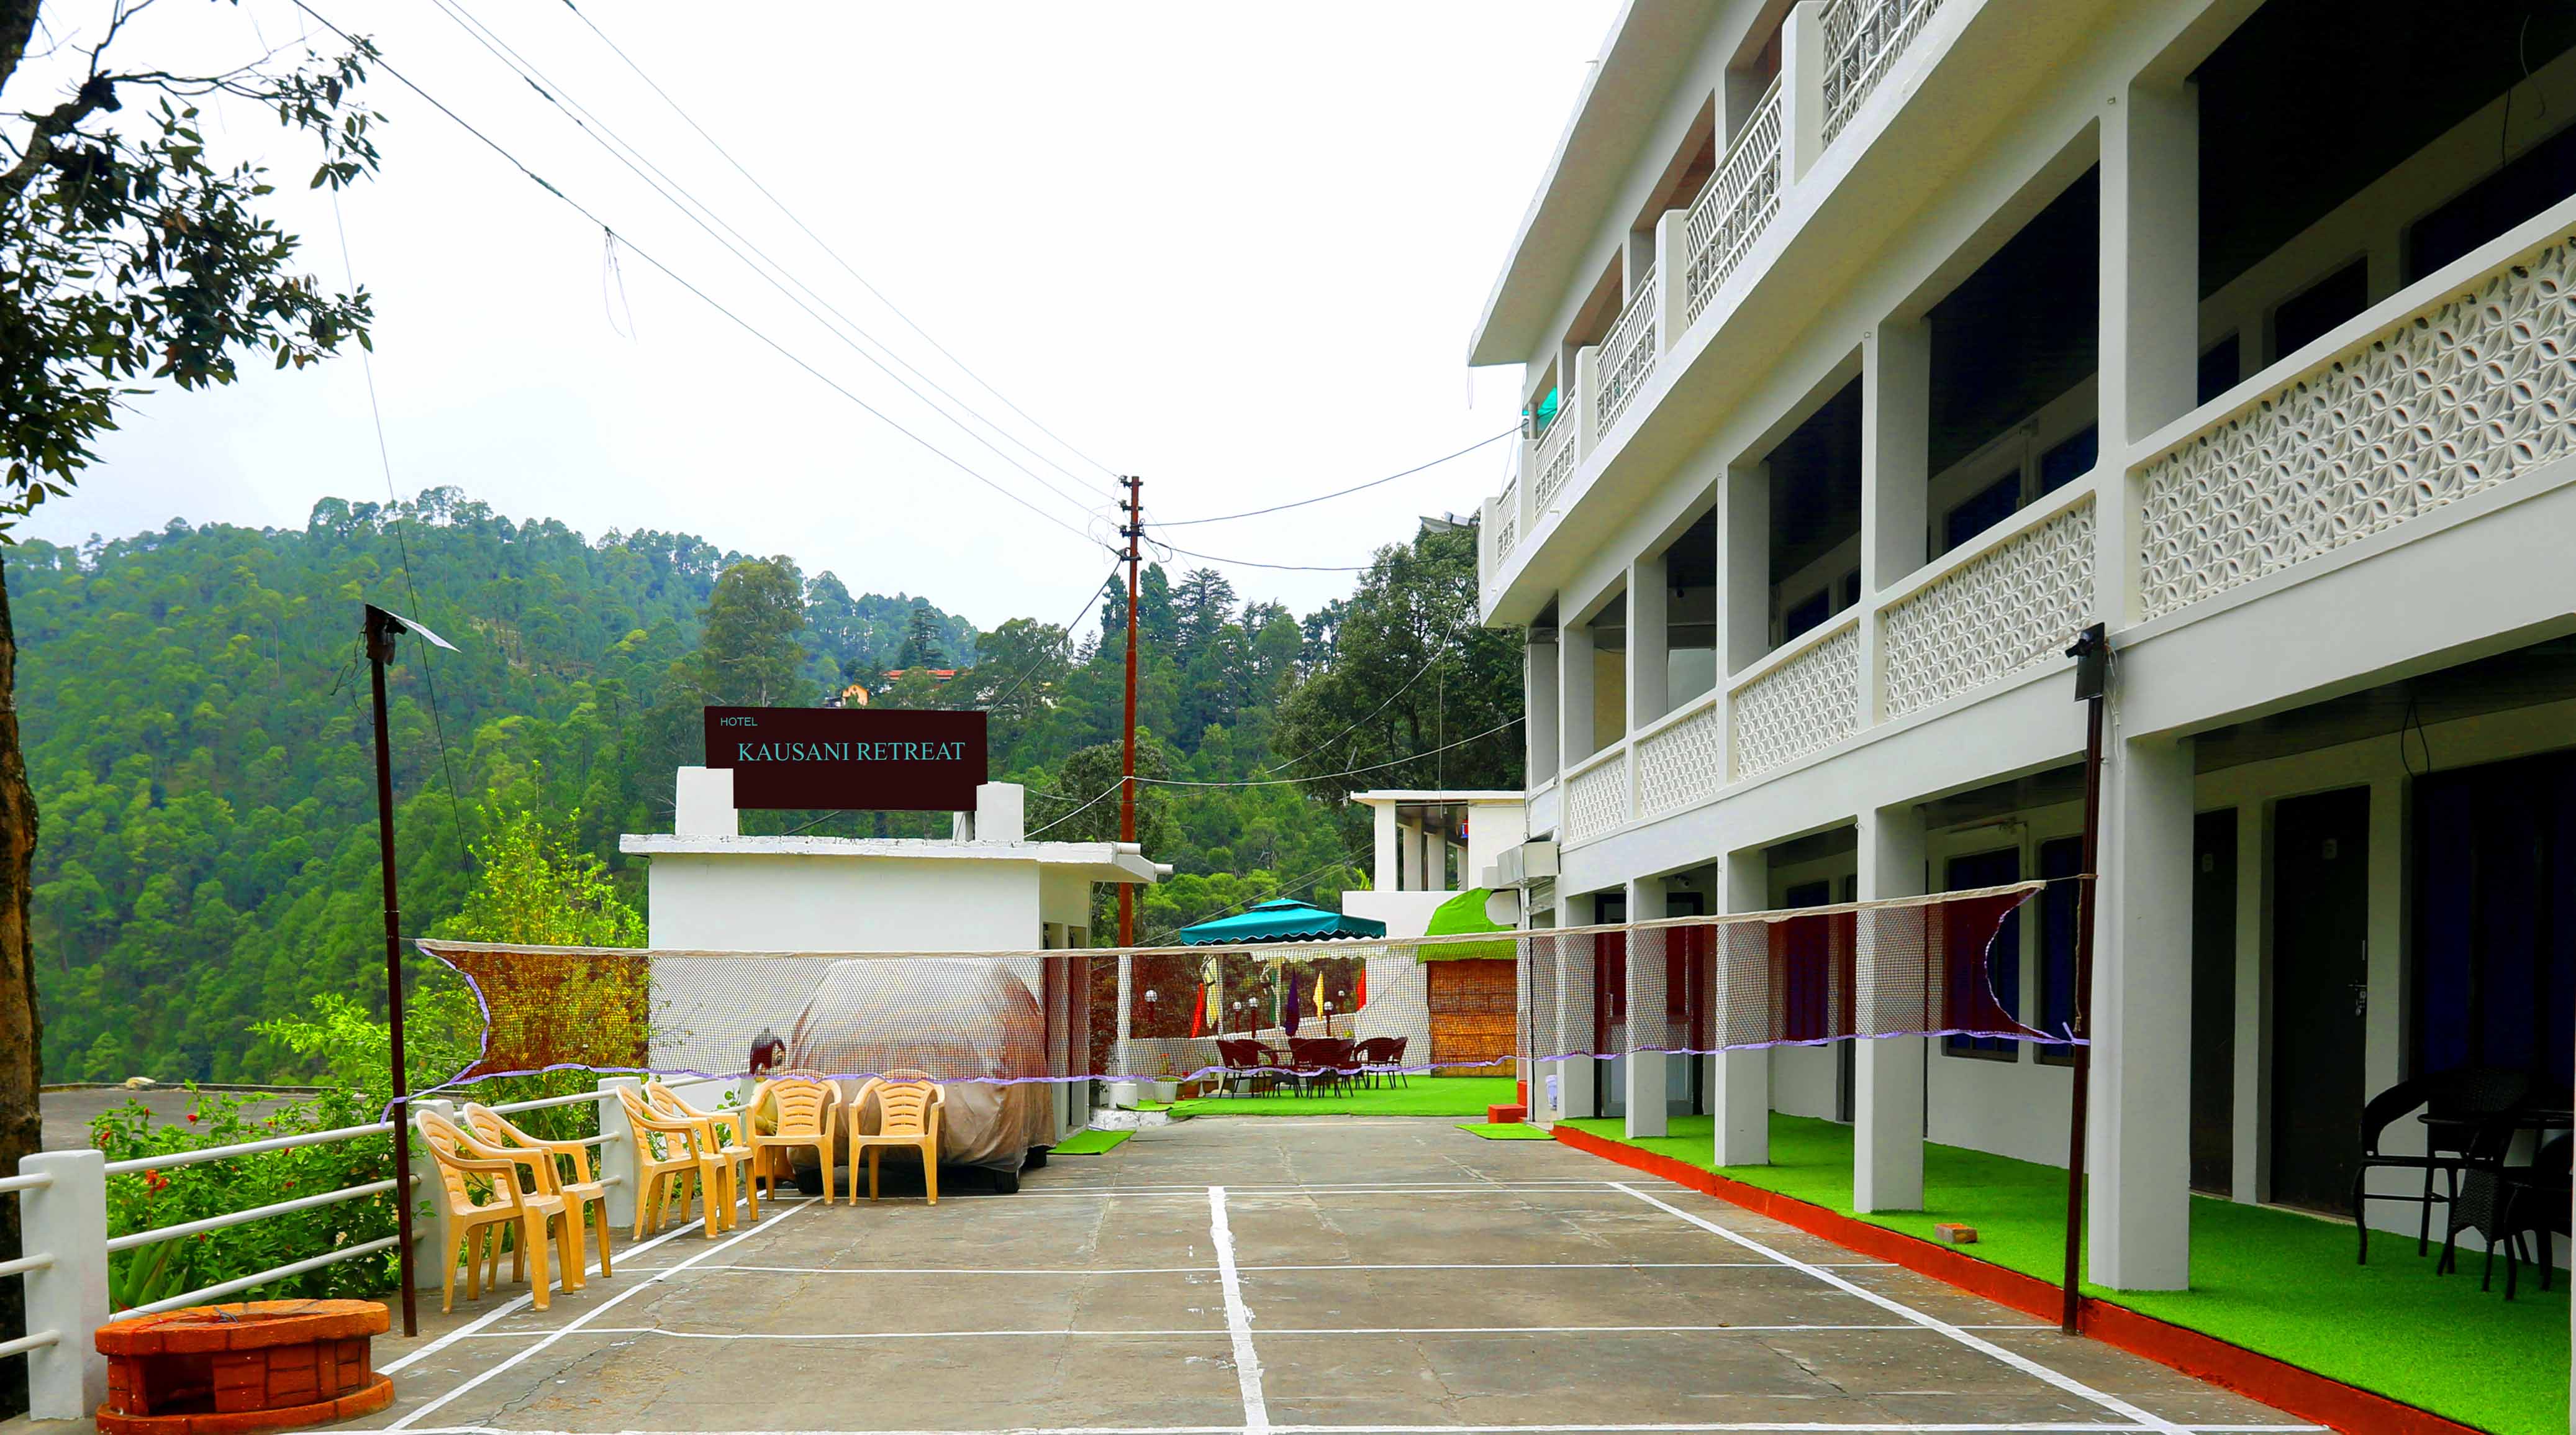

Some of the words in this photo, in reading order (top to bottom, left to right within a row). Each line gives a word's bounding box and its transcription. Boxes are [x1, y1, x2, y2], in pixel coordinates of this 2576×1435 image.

[720, 717, 758, 726] HOTEL
[738, 742, 850, 761] KAUSANI
[856, 742, 966, 760] RETREAT
